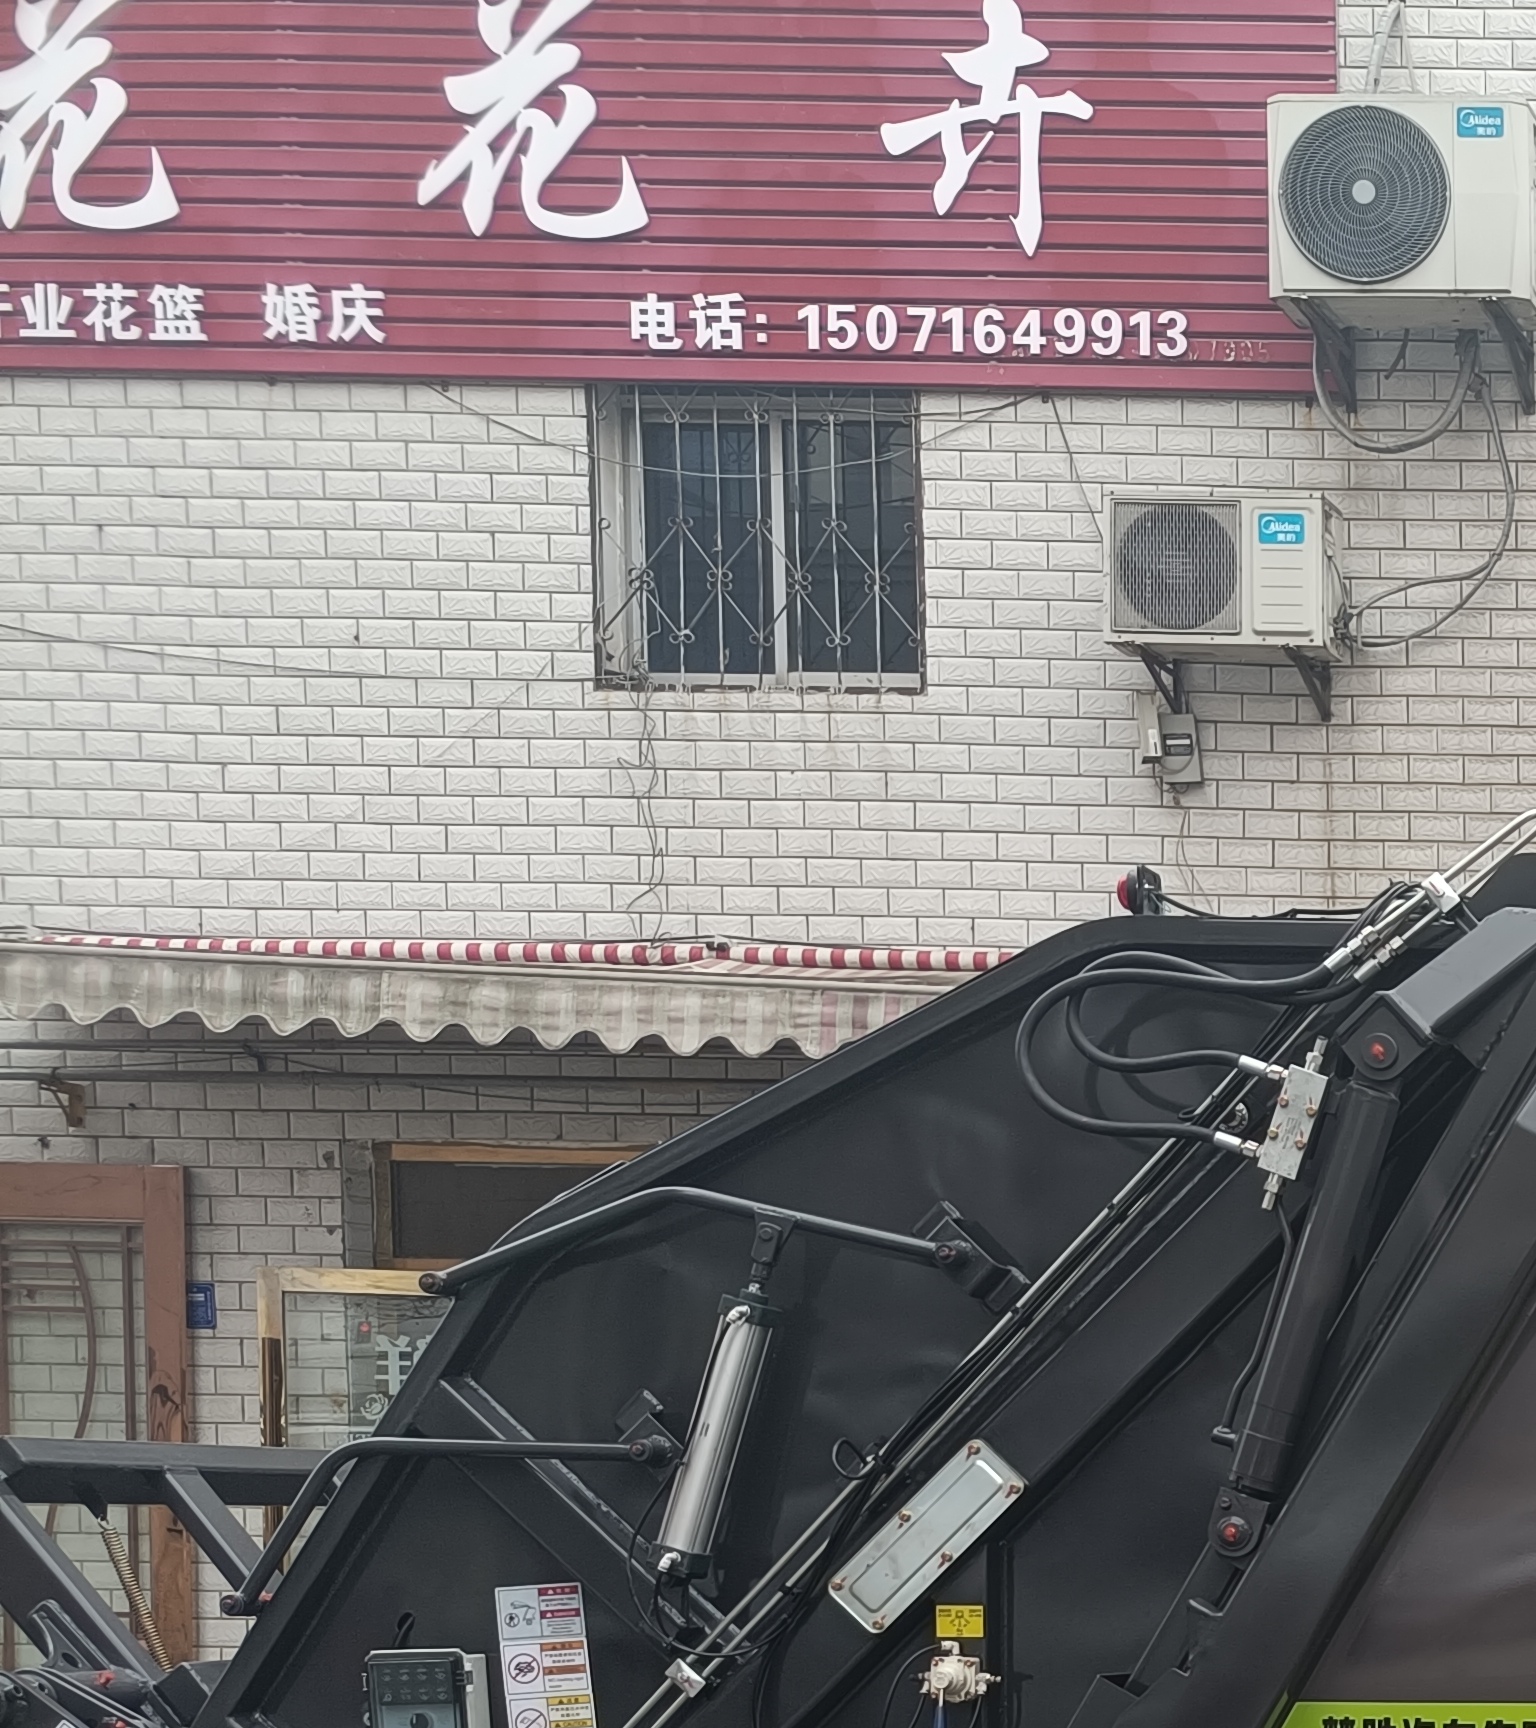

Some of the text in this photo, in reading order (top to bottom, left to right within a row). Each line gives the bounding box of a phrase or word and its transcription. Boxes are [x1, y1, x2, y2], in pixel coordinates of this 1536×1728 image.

[0, 282, 208, 342] 业花篮
[261, 282, 387, 344] 婚庆
